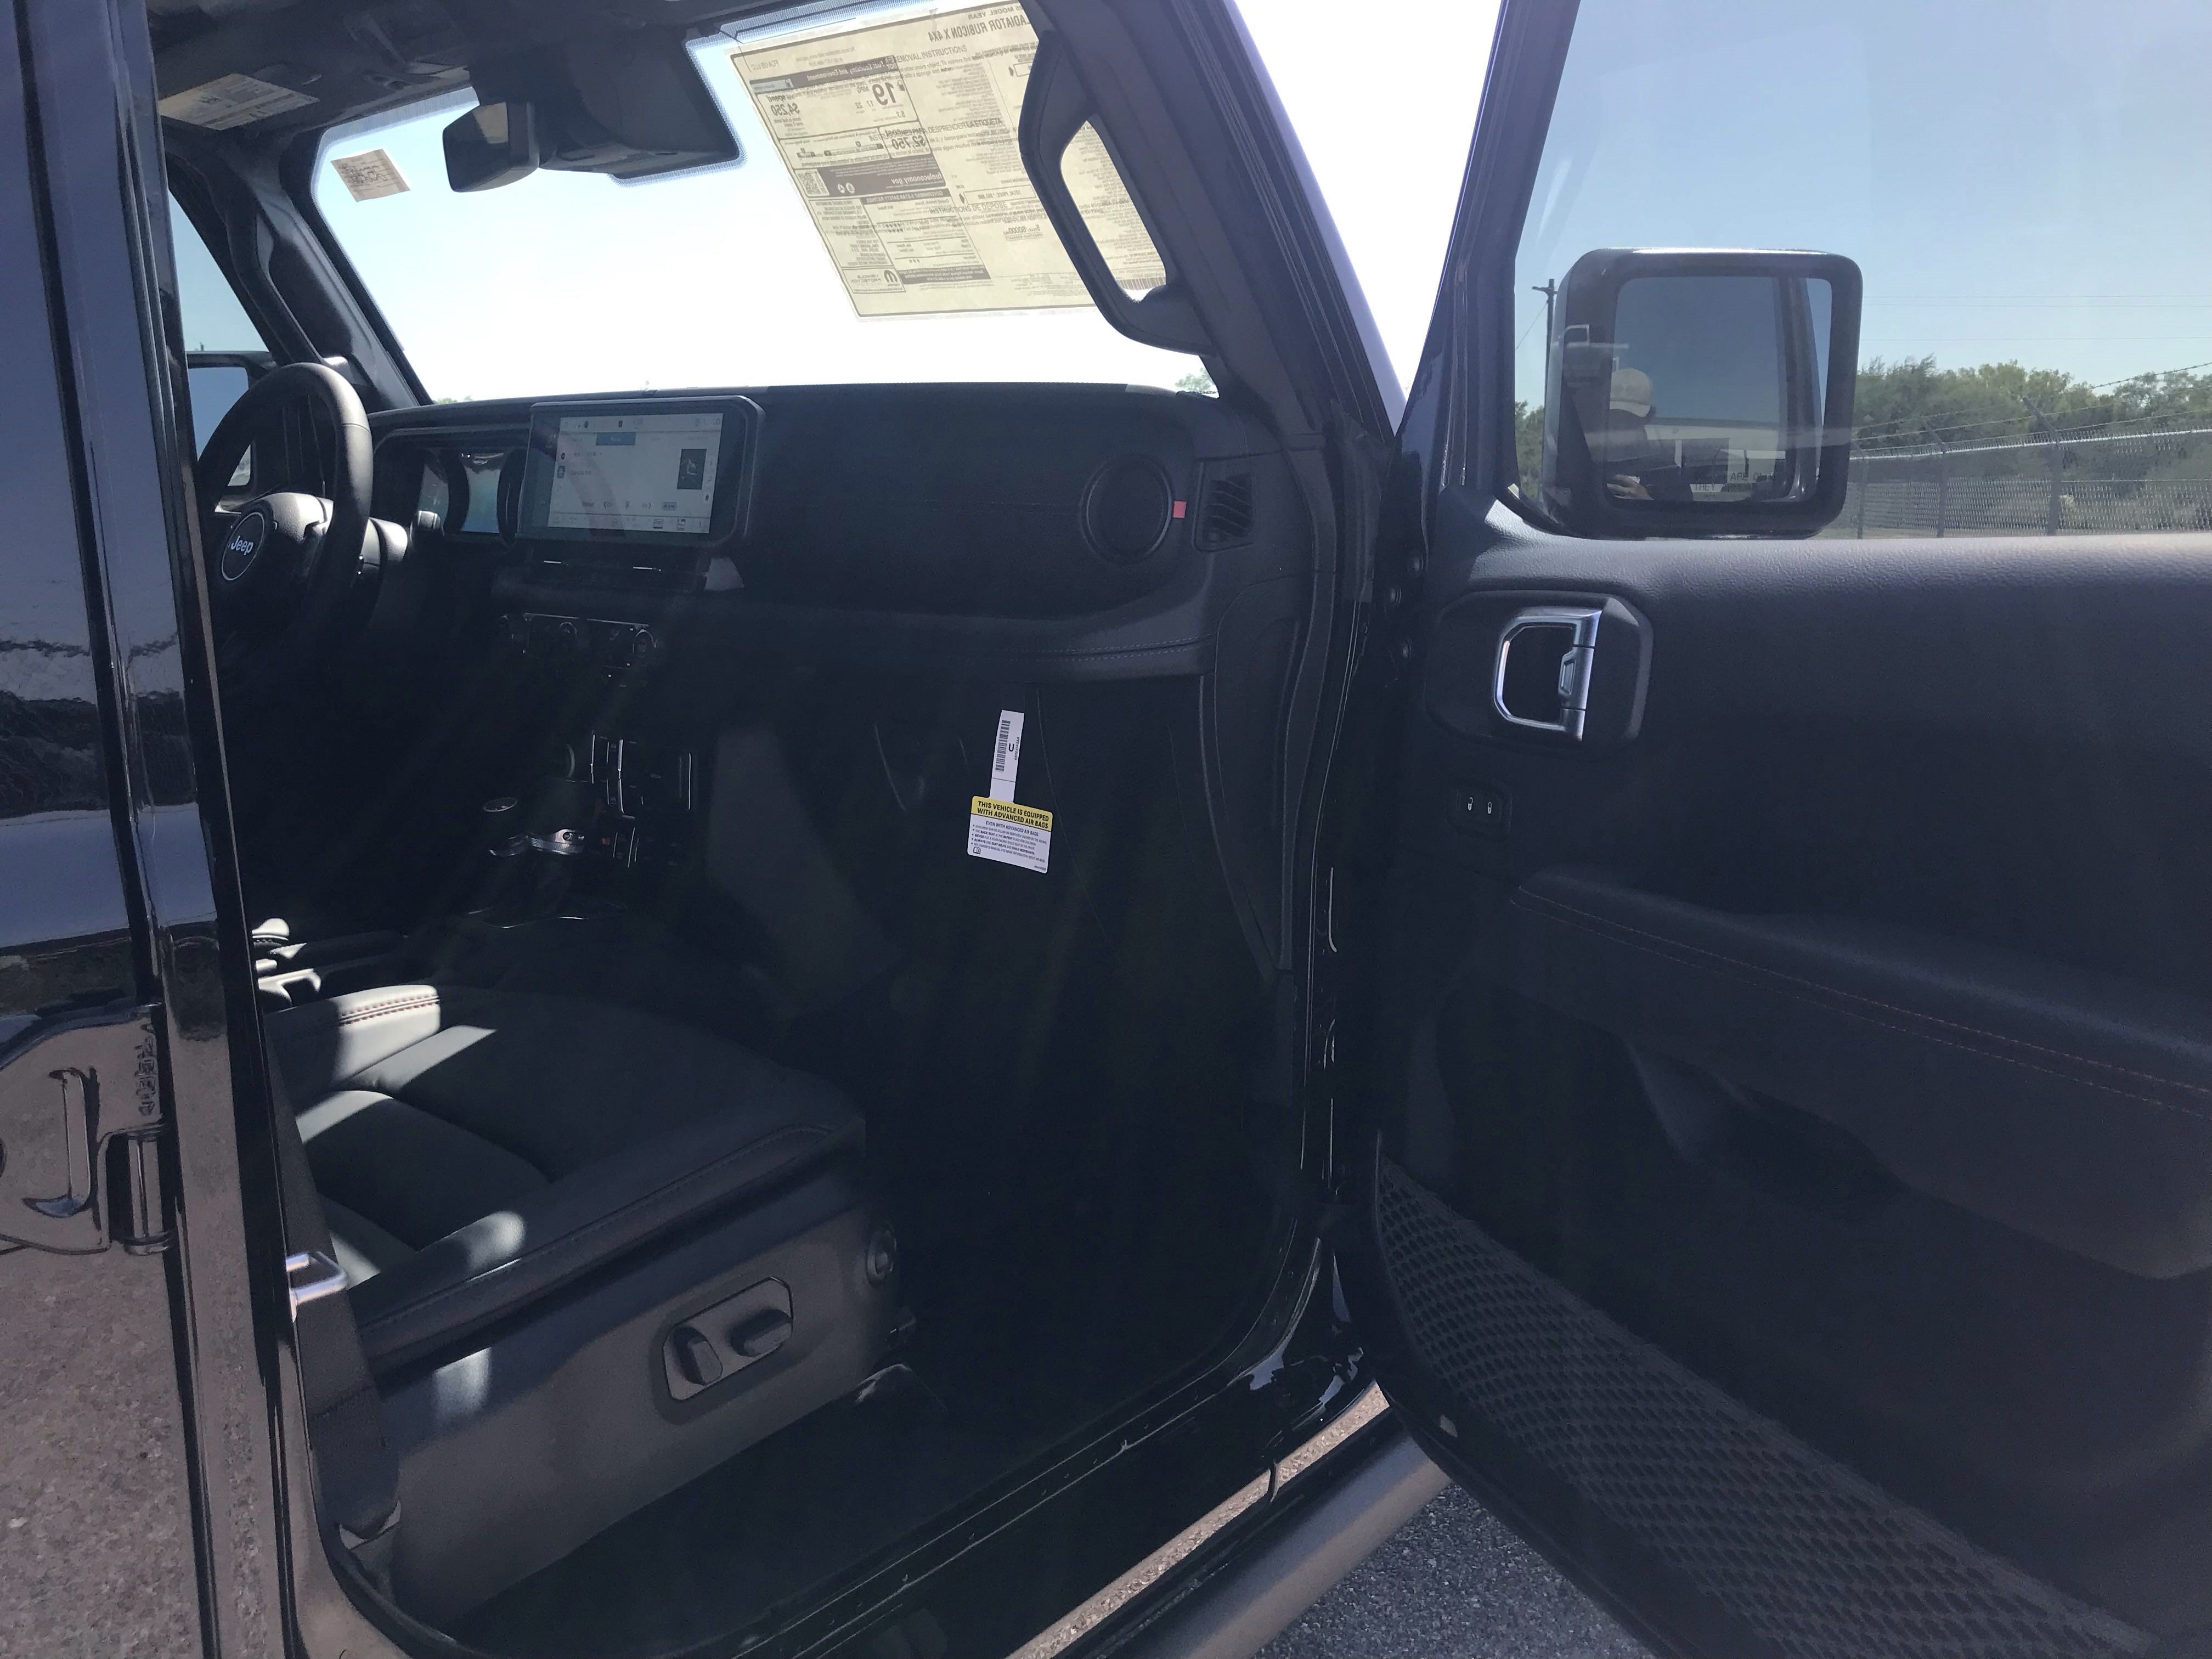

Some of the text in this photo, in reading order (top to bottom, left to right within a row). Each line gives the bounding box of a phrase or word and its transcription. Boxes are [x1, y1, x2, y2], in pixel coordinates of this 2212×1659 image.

[922, 45, 967, 58] INSTRUCTIONS
[231, 535, 253, 555] Jeep
[1009, 743, 1014, 752] U
[977, 808, 992, 816] WITH
[994, 811, 1024, 822] ADVANCED
[993, 804, 1017, 814] VEHICLE
[1024, 810, 1049, 822] EQUIPPED
[1006, 825, 1024, 833] ADVANCED
